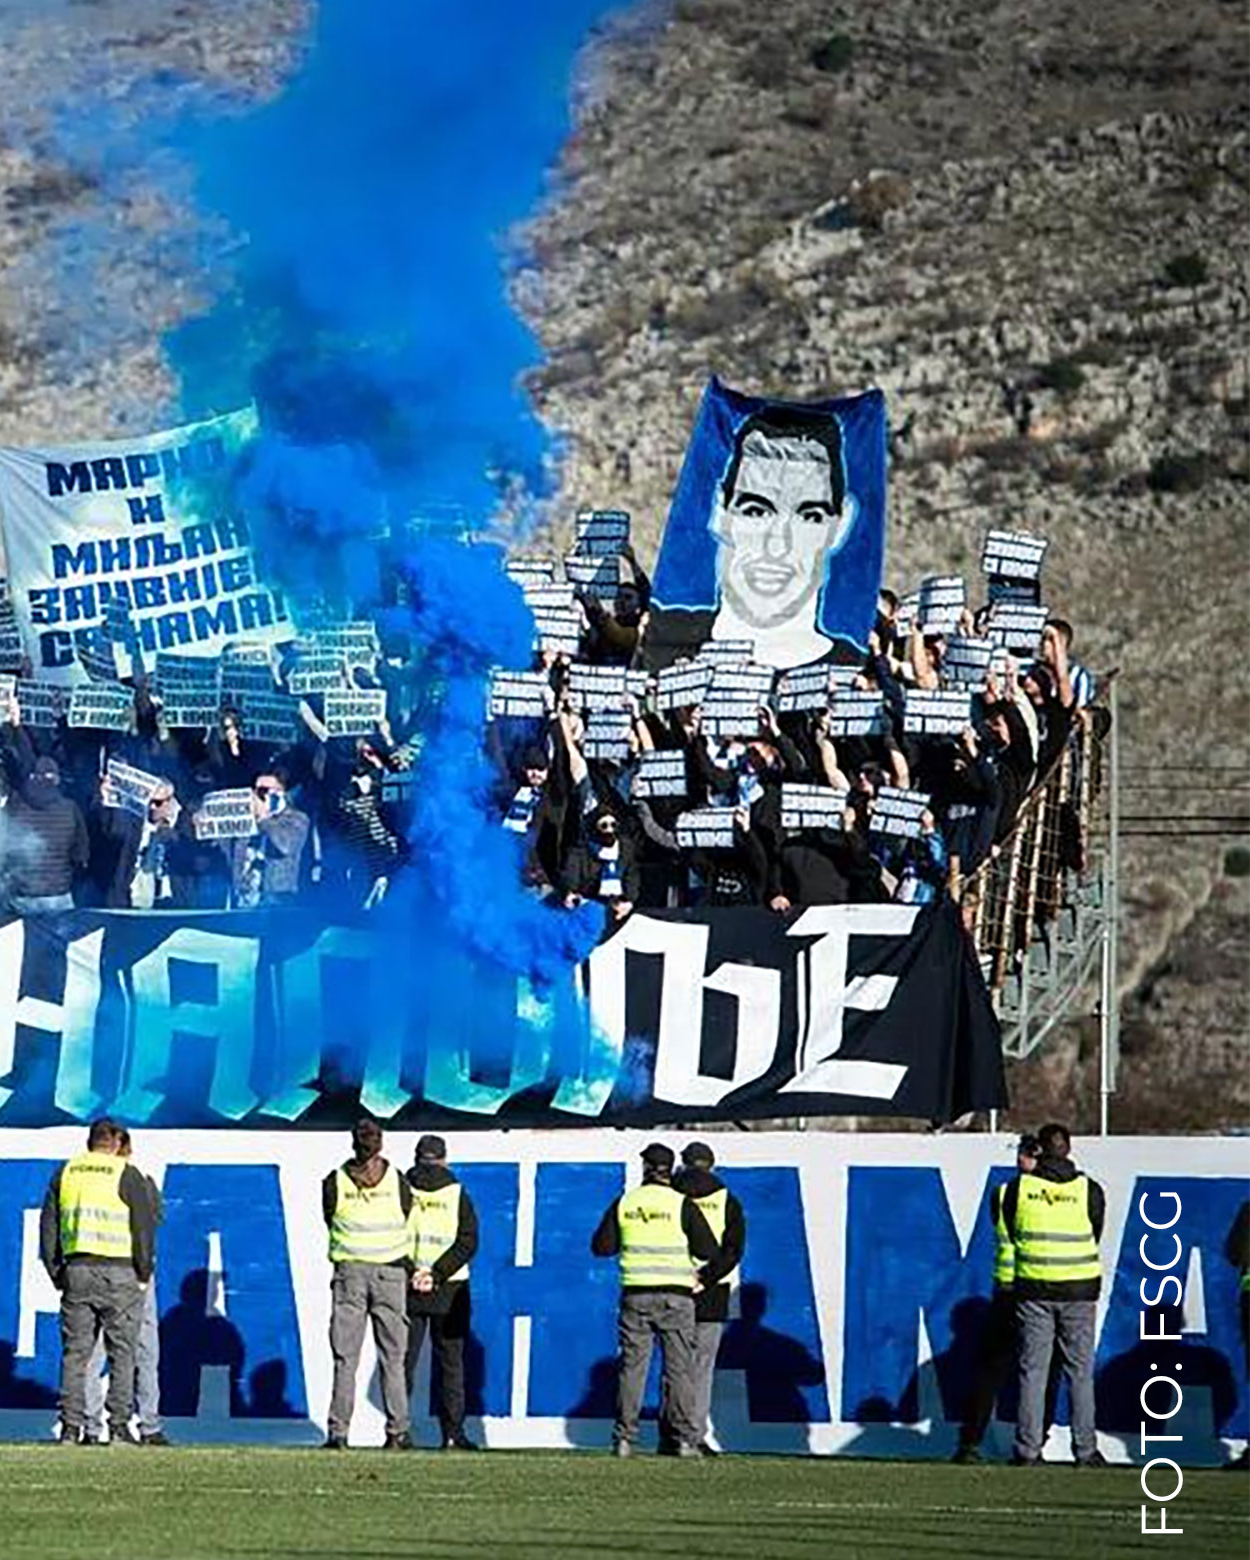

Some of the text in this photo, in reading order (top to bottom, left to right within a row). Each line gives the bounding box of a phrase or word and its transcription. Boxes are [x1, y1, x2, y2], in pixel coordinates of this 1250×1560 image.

[126, 494, 165, 525] И
[50, 514, 250, 579] МИЉАН
[28, 555, 258, 625] ЗАУВИЈЕ
